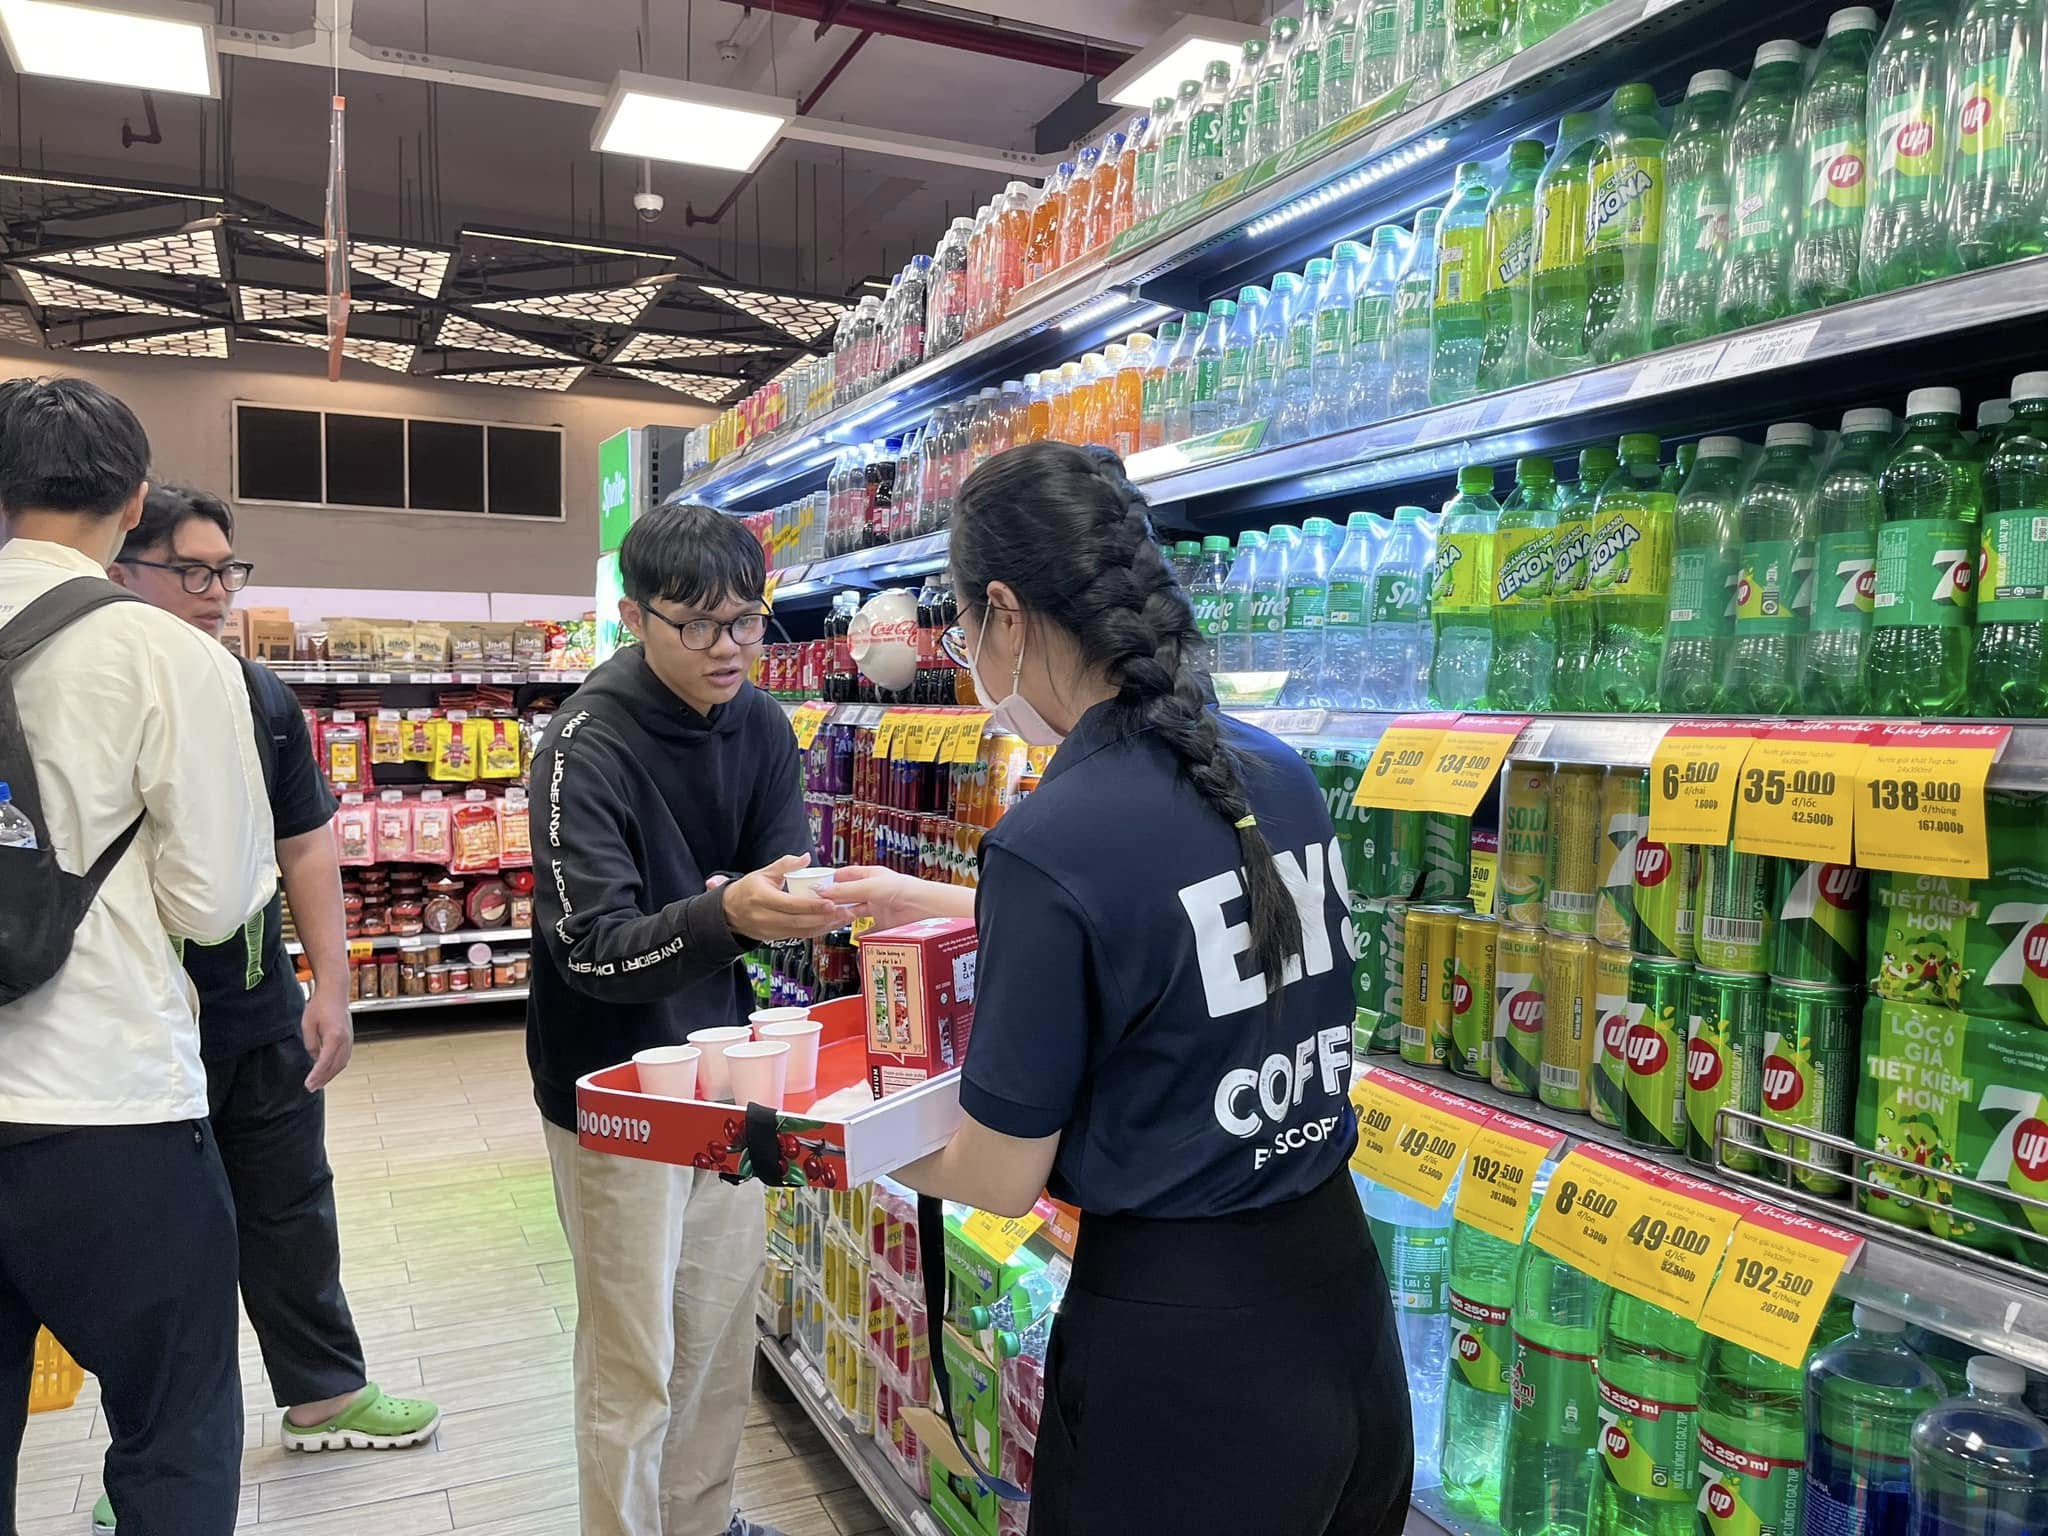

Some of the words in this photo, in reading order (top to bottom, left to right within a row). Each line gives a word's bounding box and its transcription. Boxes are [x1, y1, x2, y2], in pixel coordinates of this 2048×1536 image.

[1932, 549, 1971, 601] 7up
[561, 710, 590, 738] DKNY
[1882, 723, 1956, 738] Khuyến
[1375, 750, 1424, 776] 5.900
[1435, 754, 1490, 774] 134.000
[1663, 762, 1720, 800] 6.500
[1744, 769, 1835, 805] 35.000
[1867, 779, 1961, 811] 138.000
[549, 750, 564, 847] DKNYSPORT
[1907, 911, 1953, 931] HƠN
[1892, 1013, 1941, 1044] LỐC
[1944, 1026, 1955, 1047] 6
[1628, 1036, 1660, 1066] up
[1904, 1042, 1944, 1067] GIÁ
[1763, 1068, 1795, 1100] up
[1867, 1055, 1916, 1083] TIẾT
[1921, 1067, 1971, 1100] KIỆM
[1897, 1086, 1945, 1116] HƠN
[1400, 1128, 1457, 1160] 49.000
[1472, 1154, 1524, 1185] 192.500
[1661, 1169, 1717, 1195] Khuyến
[1556, 1181, 1618, 1215] 8.600
[1753, 1204, 1816, 1229] Khuyến
[1627, 1214, 1711, 1256] 49.000
[1734, 1257, 1814, 1297] 192.500
[1464, 1302, 1489, 1317] 250
[1490, 1310, 1506, 1321] ml
[1611, 1390, 1640, 1409] 250
[1641, 1402, 1659, 1415] ml
[1677, 1412, 1688, 1425] 7UP
[1675, 1440, 1686, 1450] CÓ
[1676, 1426, 1687, 1440] GAZ
[1715, 1444, 1748, 1466] 250
[1749, 1460, 1769, 1473] ml
[1788, 1469, 1799, 1482] 7UP
[1785, 1499, 1796, 1509] CÓ
[1787, 1484, 1798, 1498] GAZ
